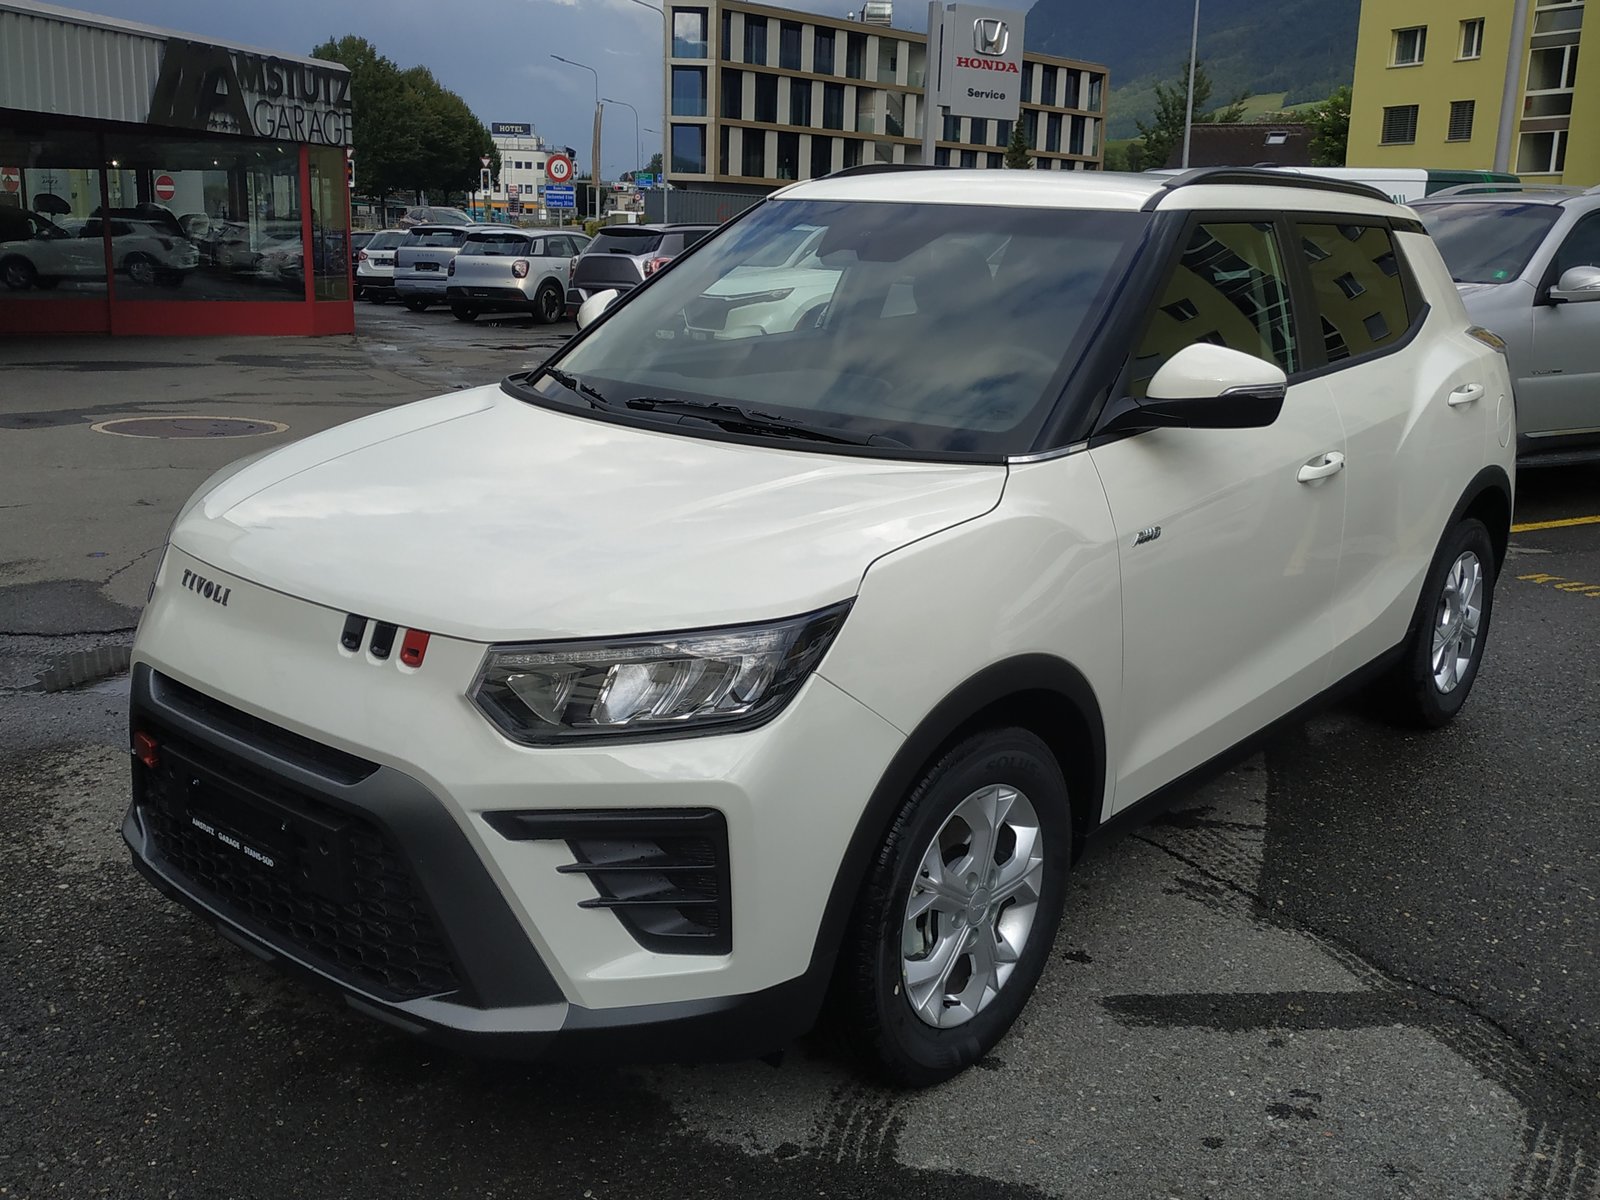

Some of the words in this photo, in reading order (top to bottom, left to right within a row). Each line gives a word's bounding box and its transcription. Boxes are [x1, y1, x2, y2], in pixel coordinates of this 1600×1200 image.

[956, 56, 1019, 73] HONDA
[967, 87, 1006, 100] Service
[499, 125, 524, 133] HOTEL
[554, 164, 565, 174] 60
[181, 568, 232, 607] TIVOLI
[191, 817, 216, 836] AMSTUTZ
[217, 831, 241, 850] GARAGE
